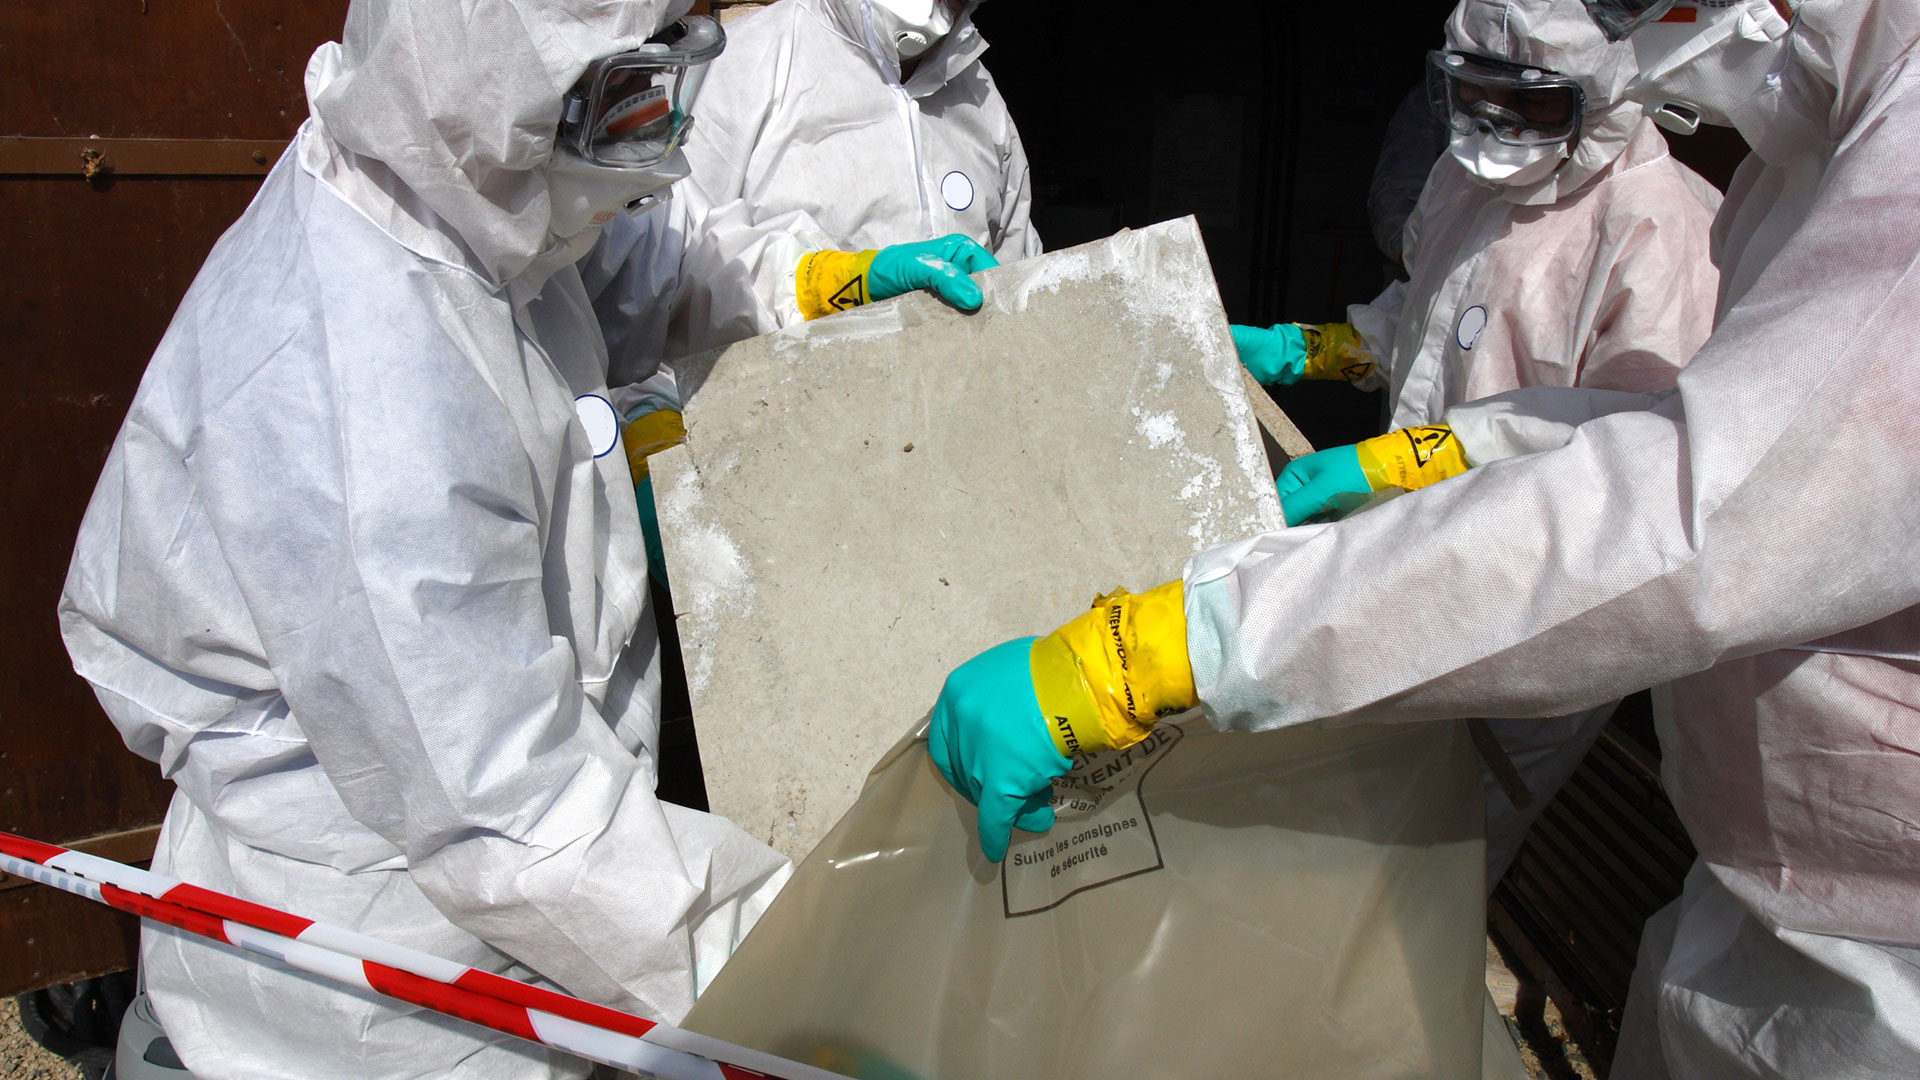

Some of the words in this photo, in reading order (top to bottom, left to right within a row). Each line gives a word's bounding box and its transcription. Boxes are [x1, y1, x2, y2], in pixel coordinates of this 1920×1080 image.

[1054, 715, 1080, 753] ATTEN
[1141, 728, 1172, 756] DE
[1013, 847, 1055, 867] Suivre
[1055, 839, 1069, 854] les
[1071, 817, 1138, 846] consignes
[1050, 865, 1061, 878] de
[1062, 843, 1108, 872] sécurité
